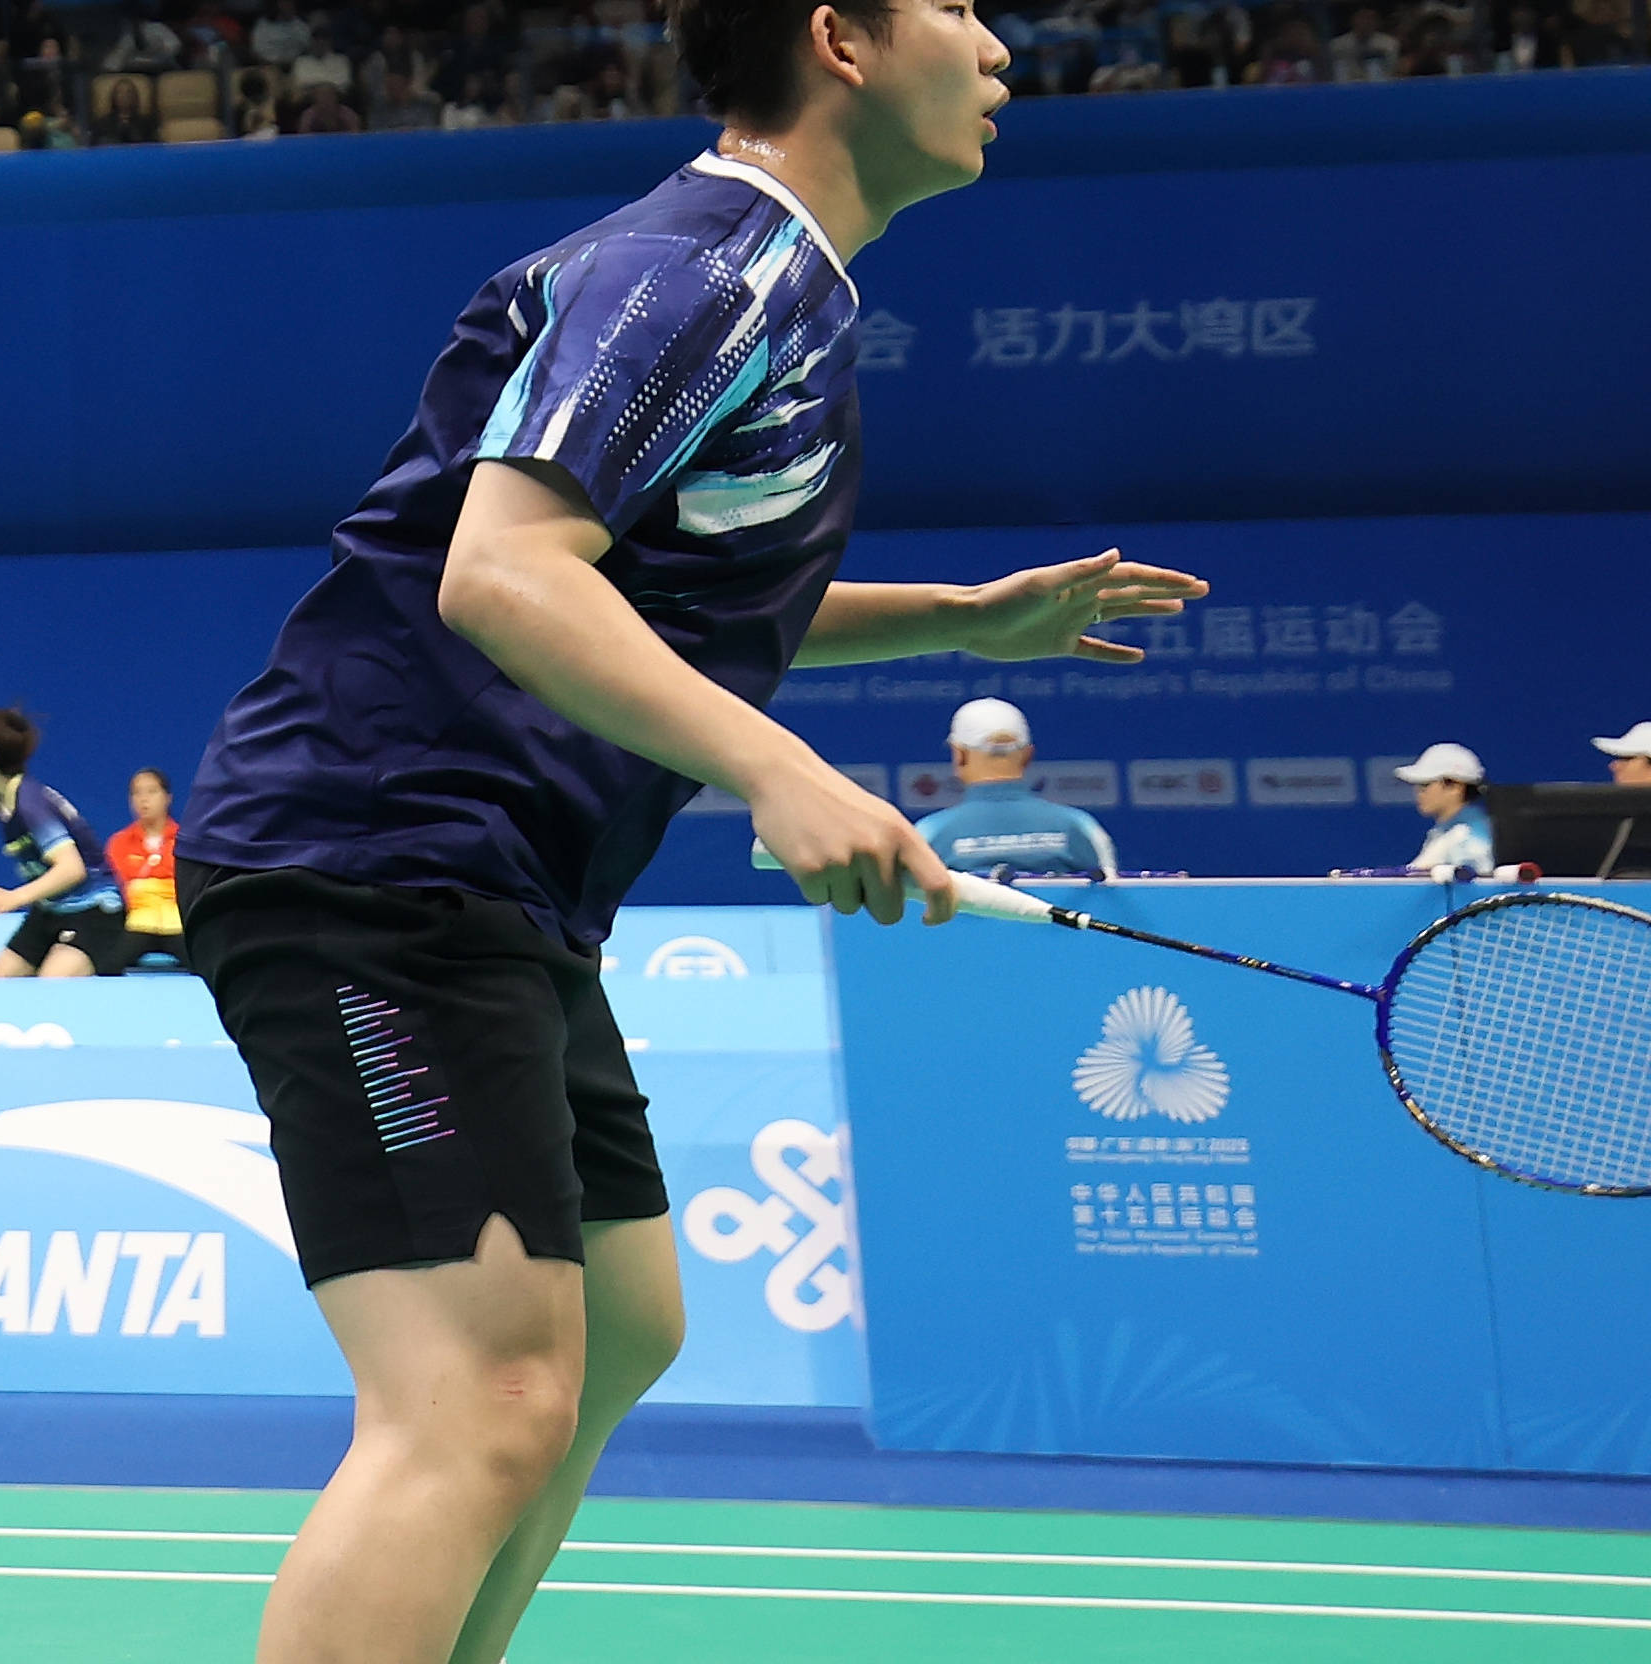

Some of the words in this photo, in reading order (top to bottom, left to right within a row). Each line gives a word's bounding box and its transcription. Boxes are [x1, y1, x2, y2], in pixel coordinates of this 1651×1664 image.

[969, 297, 1317, 367] 活力大湾区
